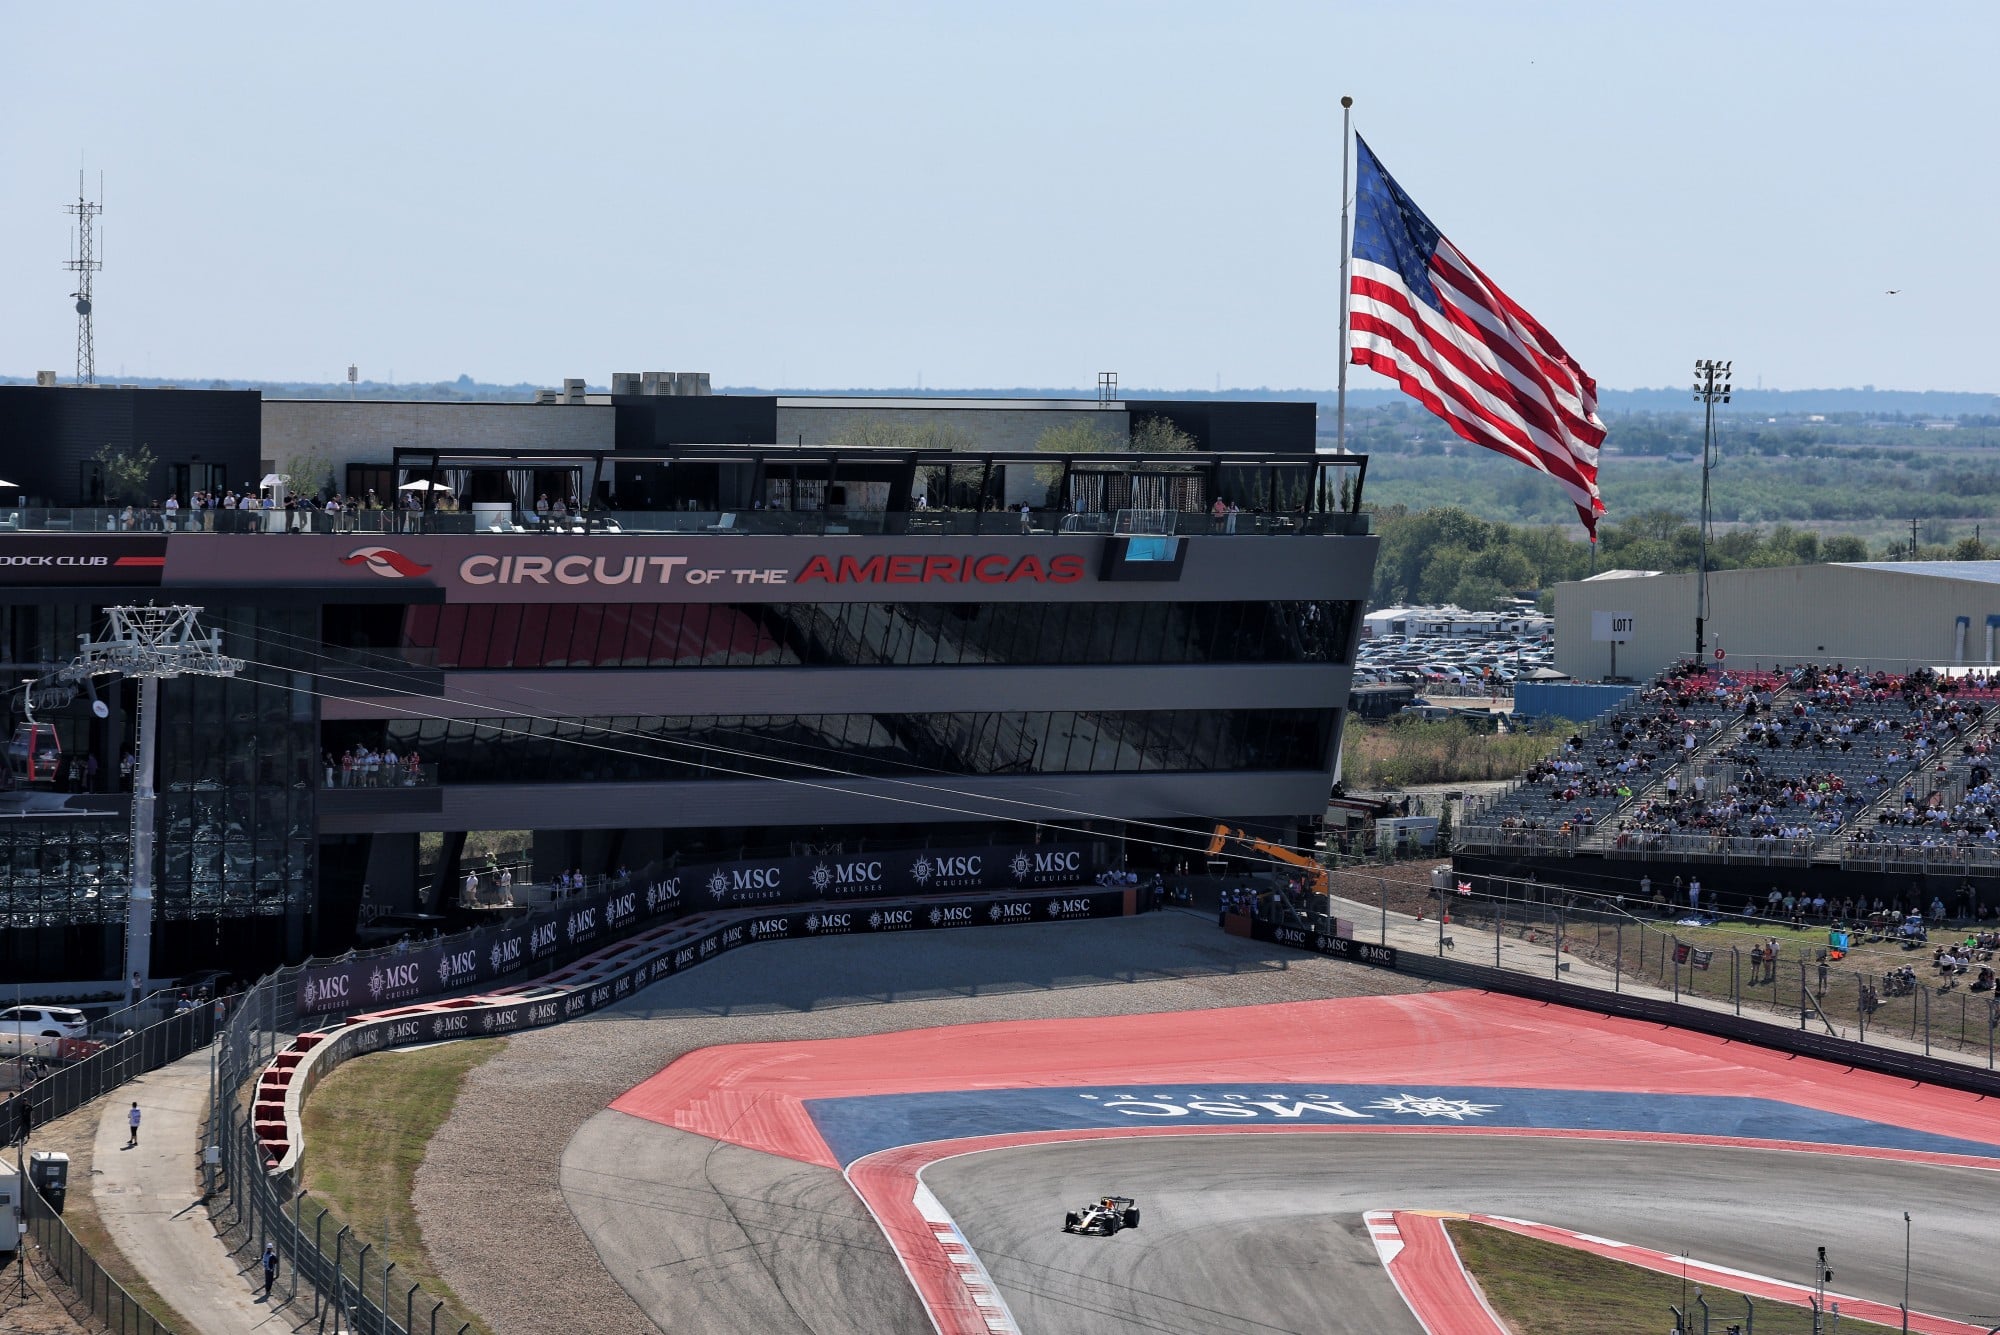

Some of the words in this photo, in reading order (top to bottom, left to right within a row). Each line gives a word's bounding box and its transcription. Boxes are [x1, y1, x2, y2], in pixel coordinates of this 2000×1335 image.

[56, 556, 108, 566] CLUB
[459, 554, 688, 585] CIRCUIT
[685, 569, 726, 585] OF
[730, 569, 789, 584] THE
[793, 554, 1087, 585] AMERICAS
[1613, 618, 1626, 632] LOT
[935, 855, 982, 877] MSC
[1034, 851, 1080, 873] MSC
[732, 867, 781, 890] MSC
[835, 861, 882, 883] MSC
[1034, 874, 1080, 883] CRUISES
[657, 877, 681, 903] MSC
[835, 884, 882, 894] CRUISES
[935, 878, 982, 887] CRUISES
[732, 891, 781, 901] CRUISES
[615, 892, 636, 919] MSC
[1003, 903, 1031, 916] MSC
[1062, 898, 1090, 912] MSC
[576, 907, 596, 933] MSC
[821, 913, 850, 928] MSC
[883, 910, 912, 924] MSC
[943, 906, 972, 920] MSC
[758, 918, 788, 933] MSC
[538, 921, 557, 947] MSC
[1285, 929, 1305, 943] MSC
[502, 936, 522, 962] MSC
[1327, 938, 1348, 951] MSC
[1369, 947, 1391, 961] MSC
[451, 949, 476, 976] MSC
[386, 962, 419, 990] MSC
[318, 974, 349, 1000] MSC
[385, 987, 420, 1000] CRUISES
[571, 994, 586, 1010] MSC
[495, 1010, 518, 1025] MSC
[538, 1002, 557, 1018] MSC
[396, 1021, 419, 1037] MSC
[444, 1015, 468, 1030] MSC
[1103, 1101, 1376, 1118] MSC
